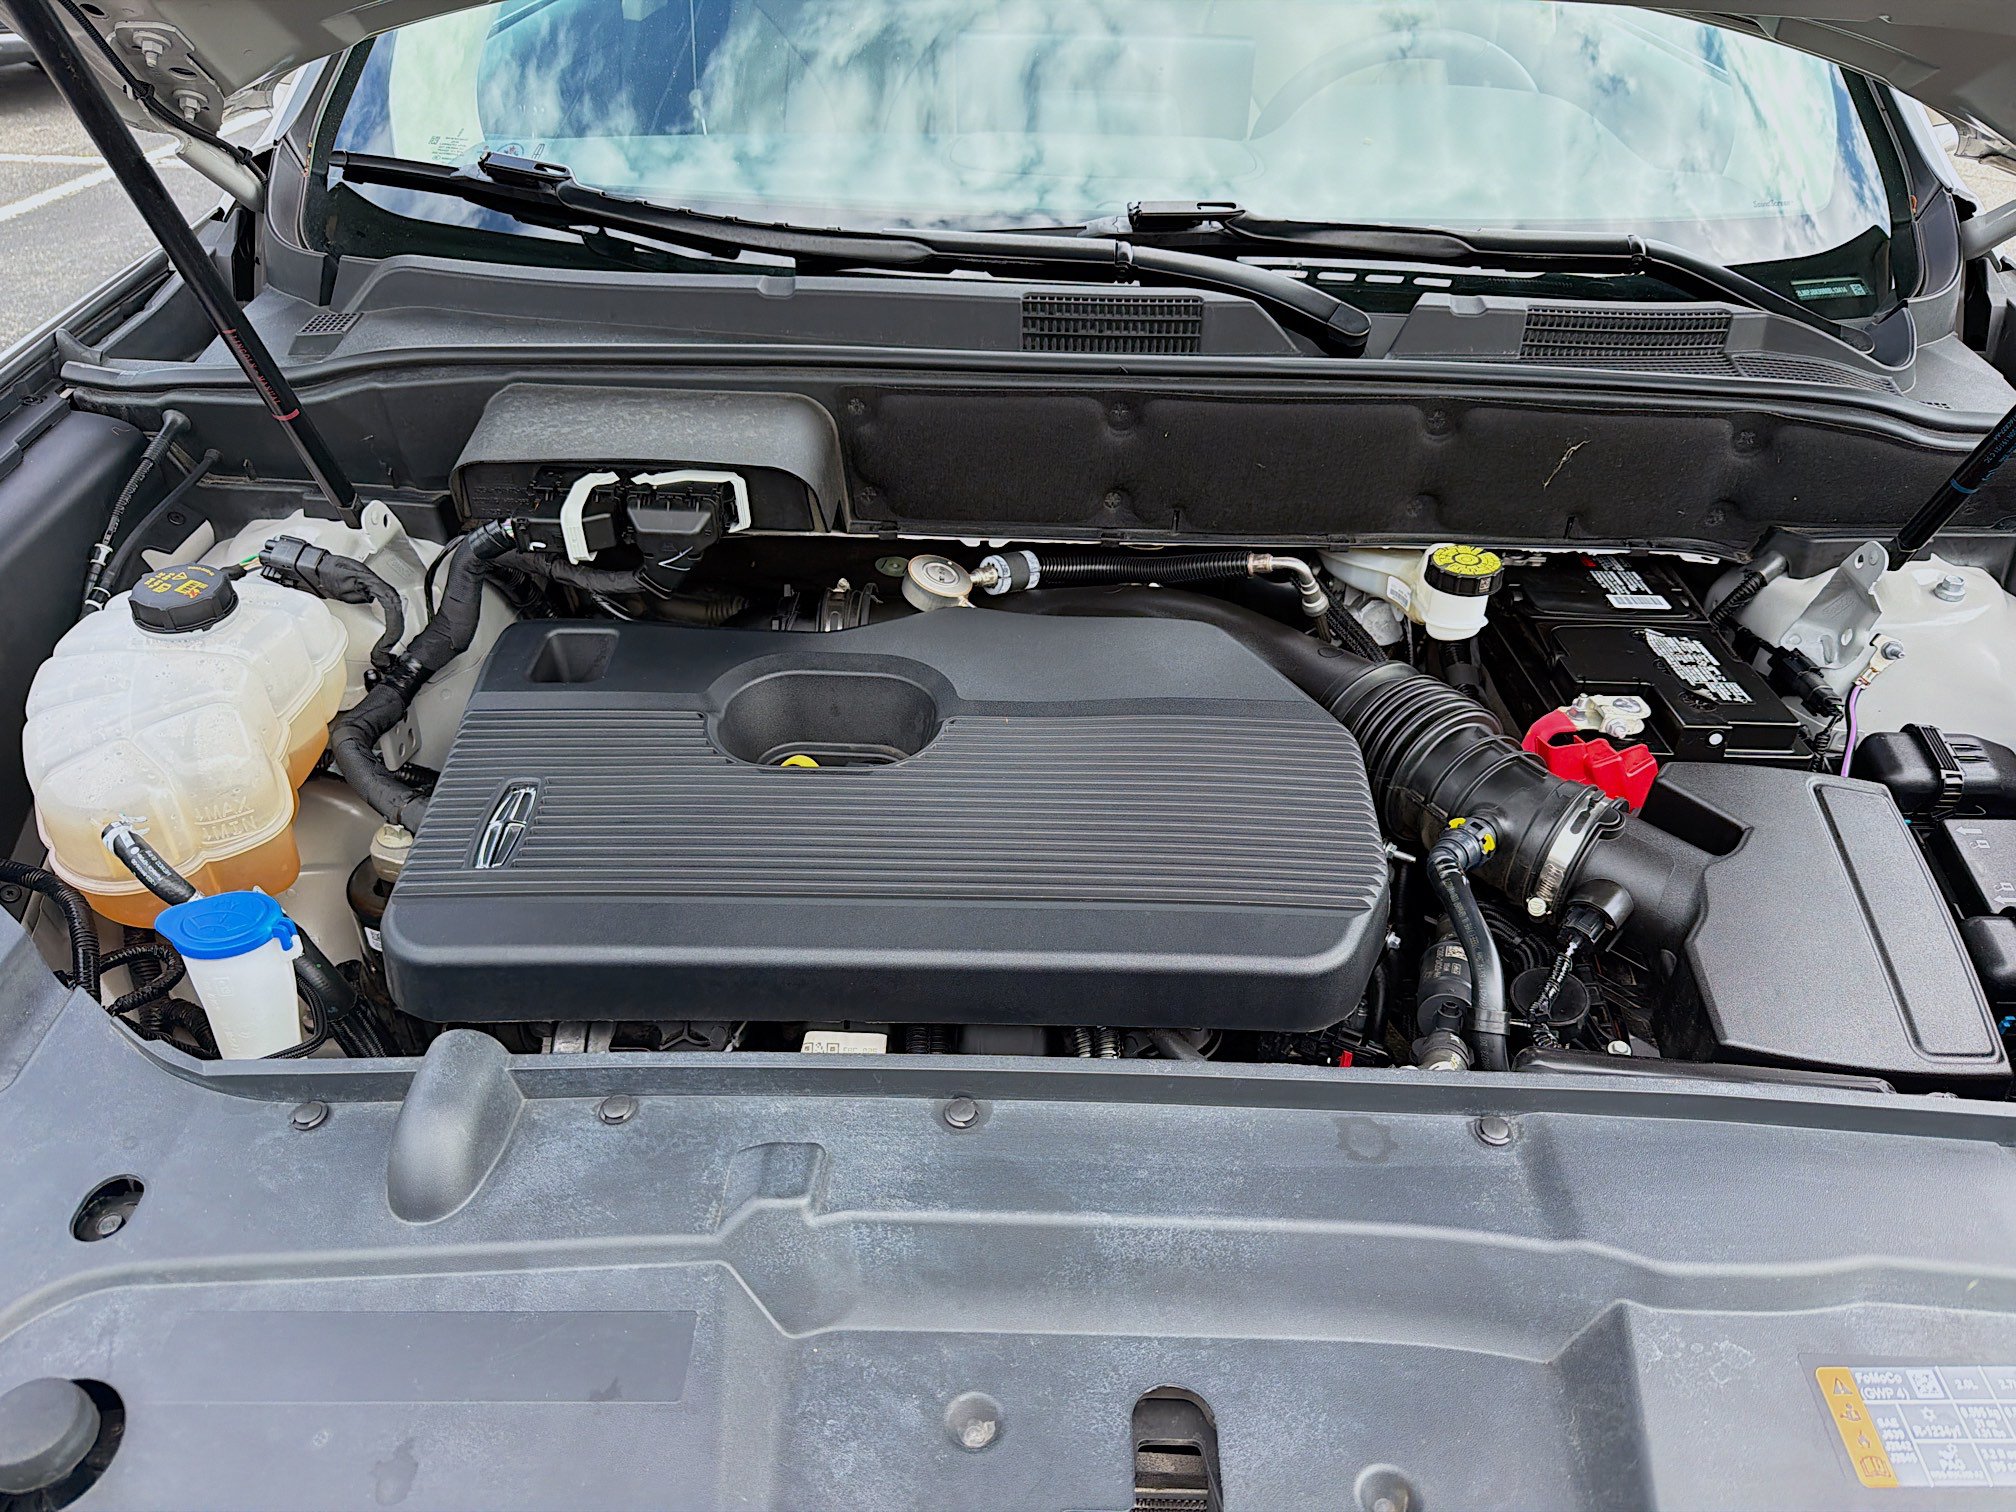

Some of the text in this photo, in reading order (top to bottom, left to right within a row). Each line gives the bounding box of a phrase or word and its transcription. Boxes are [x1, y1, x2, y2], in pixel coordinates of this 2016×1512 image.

[231, 335, 258, 369] LINCOLN
[1855, 1372, 1902, 1384] FoMoCo
[1861, 1387, 1910, 1400] (GWP 4)
